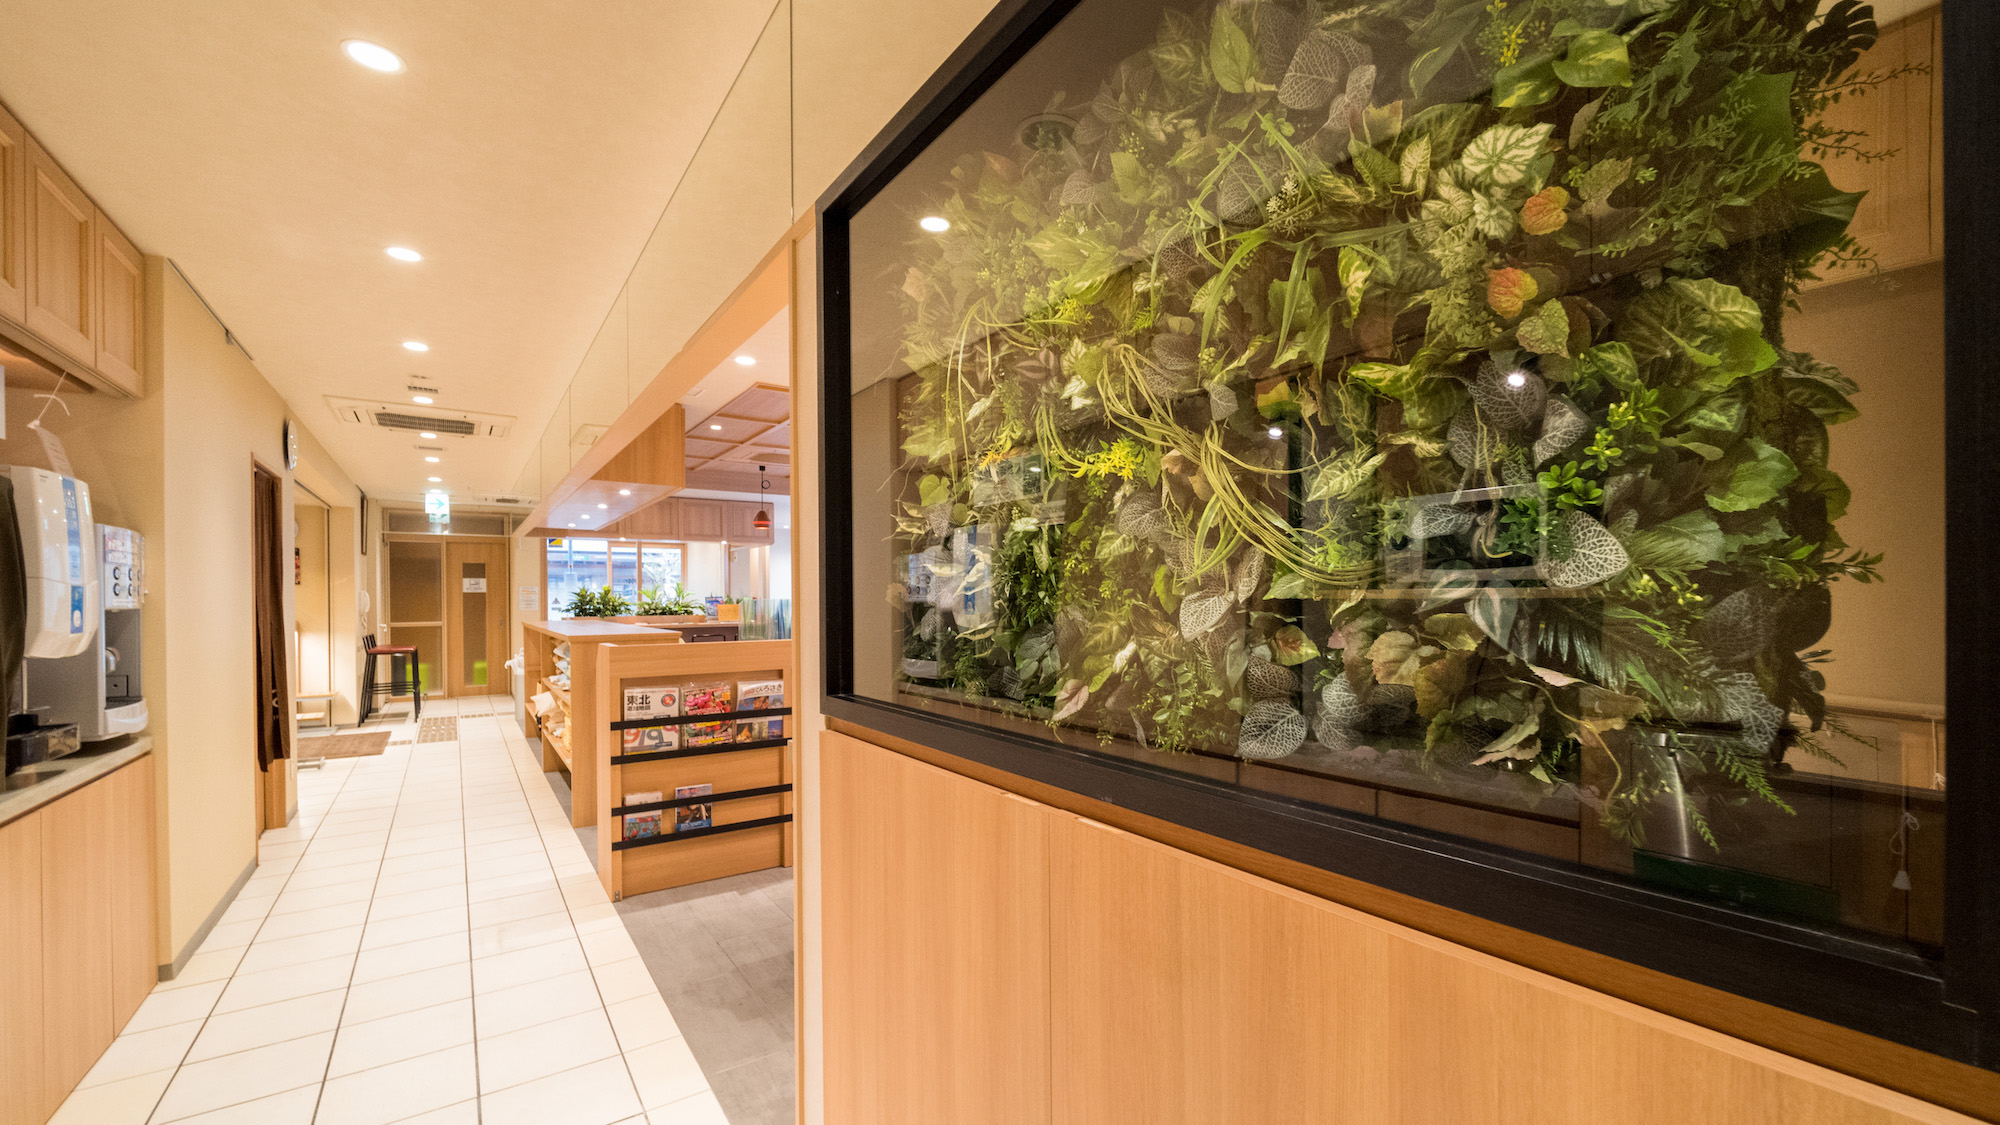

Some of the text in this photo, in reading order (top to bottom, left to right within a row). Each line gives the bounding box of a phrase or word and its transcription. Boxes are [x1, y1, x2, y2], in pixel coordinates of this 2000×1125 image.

[755, 684, 782, 694] ひろさき
[626, 694, 651, 705] 東北
